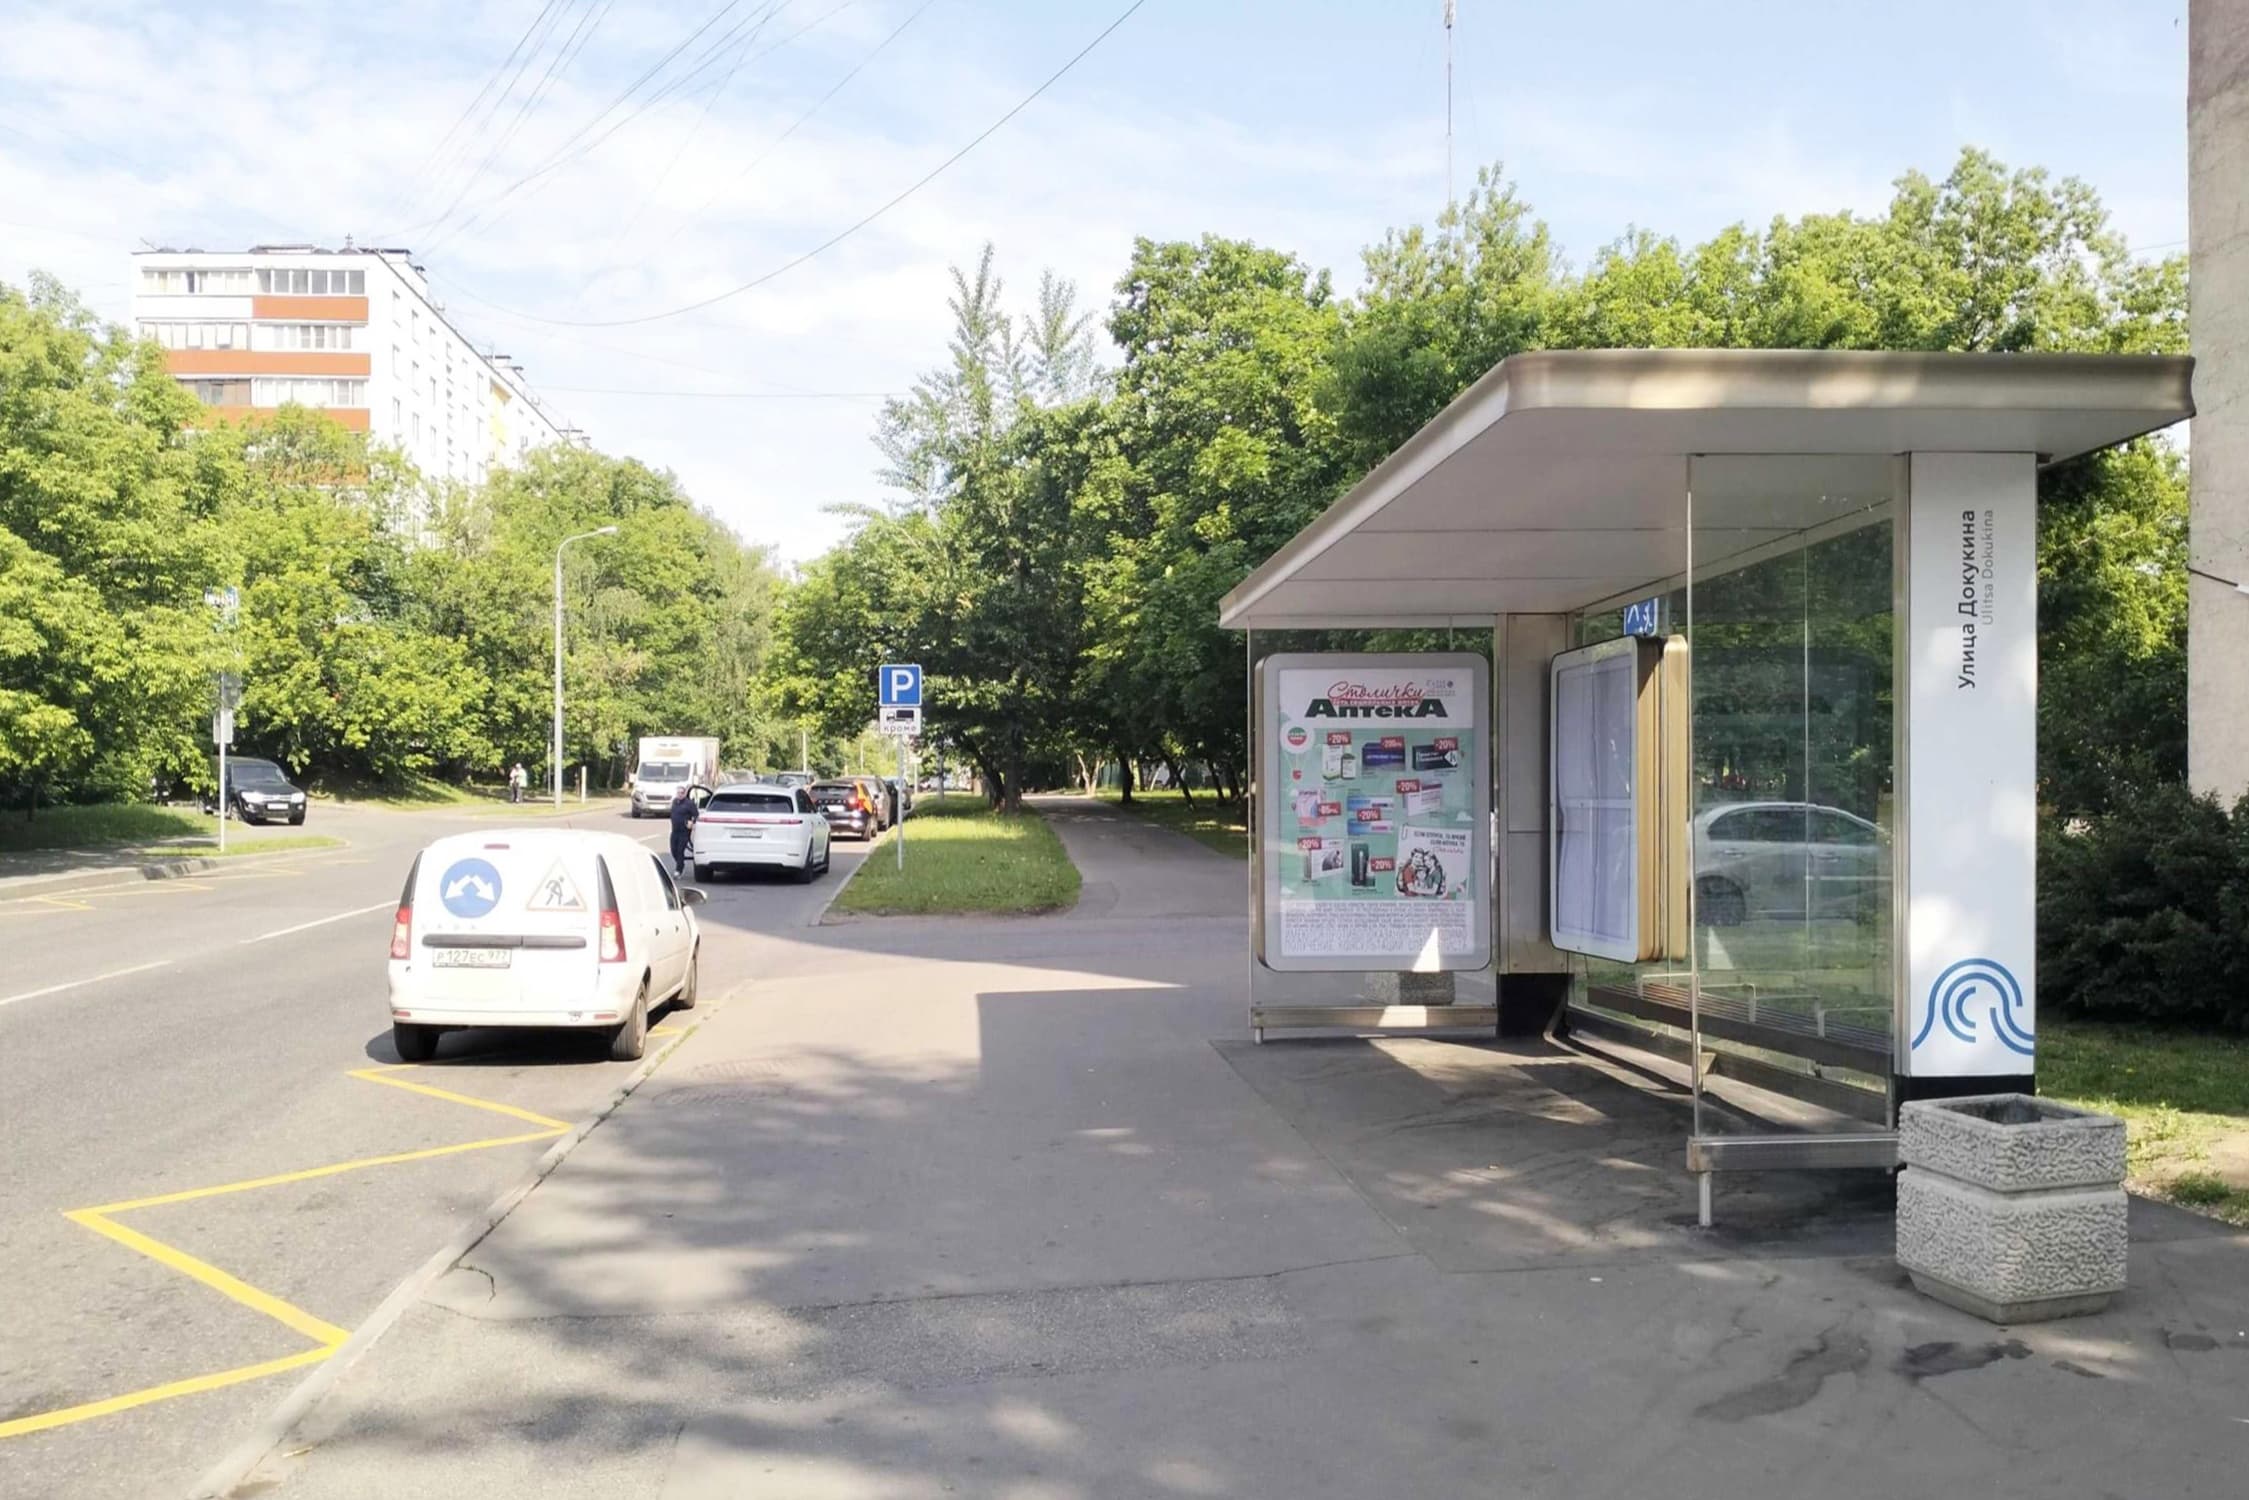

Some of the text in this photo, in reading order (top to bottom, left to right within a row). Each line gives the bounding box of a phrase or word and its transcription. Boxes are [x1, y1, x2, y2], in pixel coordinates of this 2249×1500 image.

[1982, 510, 1994, 625] Ulitsa Dokukina
[1958, 510, 1979, 689] Улица Докукина
[1328, 681, 1425, 698] Столички
[1328, 734, 1349, 744] -20%
[1435, 739, 1456, 749] -20%
[1397, 781, 1418, 791] -20%
[1358, 810, 1379, 820] -20%
[1371, 859, 1393, 870] -20%
